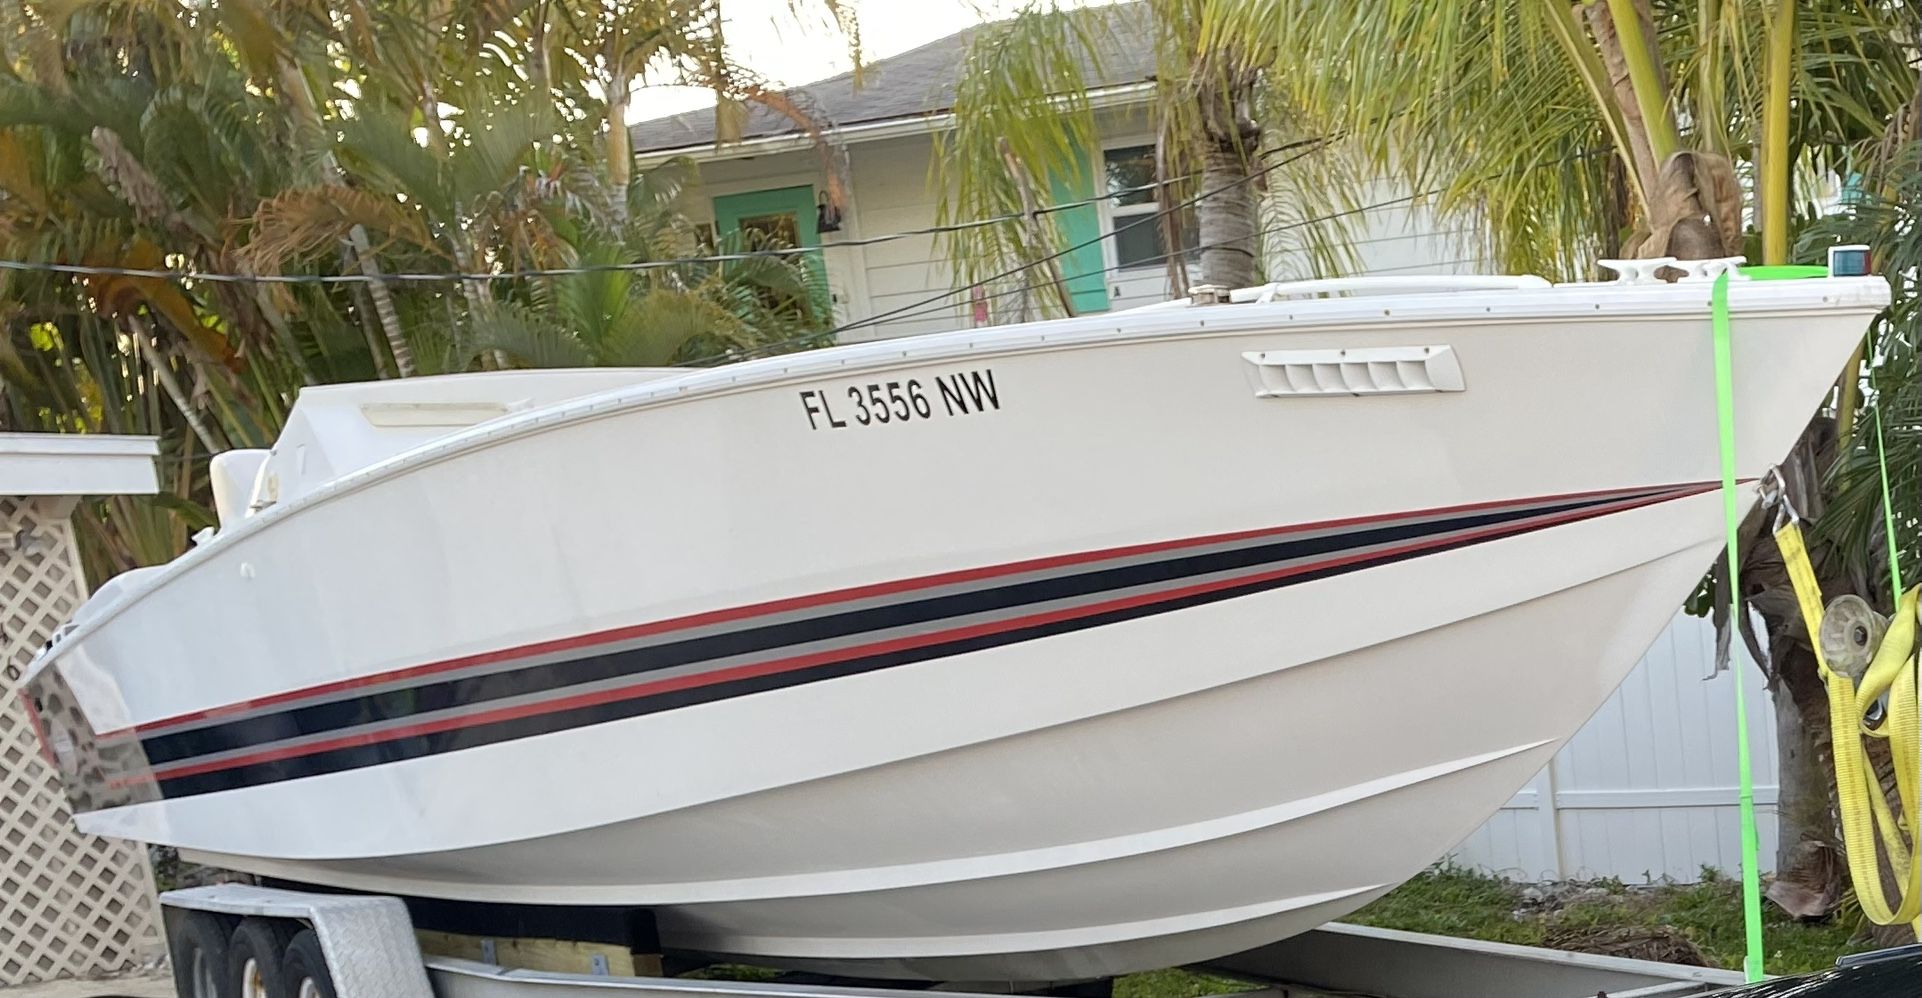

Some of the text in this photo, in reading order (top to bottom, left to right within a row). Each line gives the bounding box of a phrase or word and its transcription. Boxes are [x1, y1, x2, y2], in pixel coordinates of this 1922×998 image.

[799, 369, 1000, 430] FL 3556 NW
